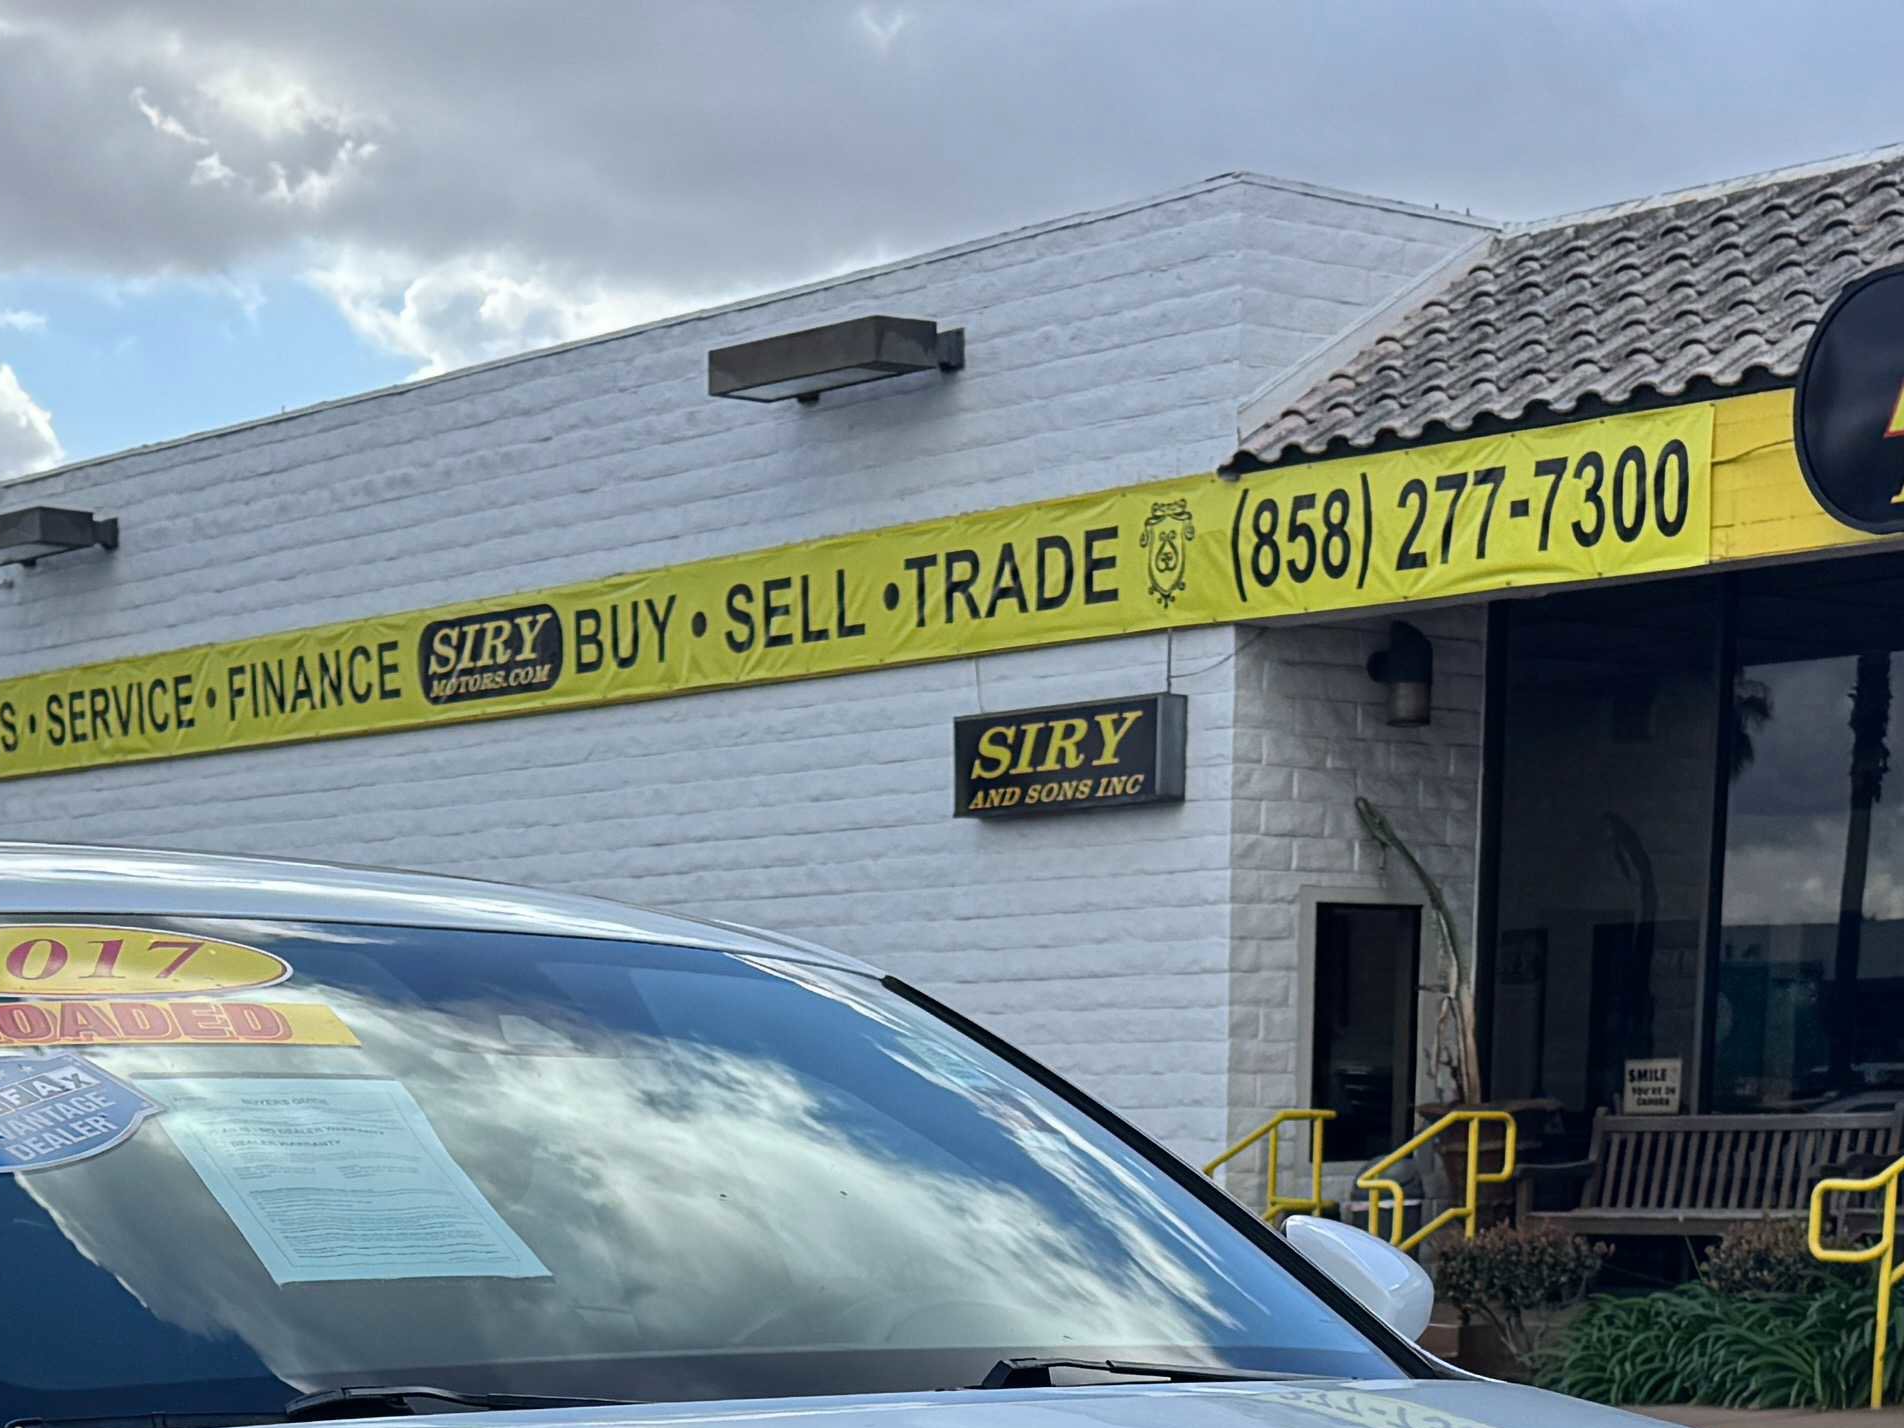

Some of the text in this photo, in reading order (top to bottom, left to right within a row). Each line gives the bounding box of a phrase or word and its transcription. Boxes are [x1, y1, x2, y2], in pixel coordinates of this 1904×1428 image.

[1230, 438, 1692, 604] (858) 277-7300
[574, 525, 1121, 674] BUY SELL TRADE
[428, 612, 552, 676] SIRY
[47, 673, 196, 746] SERVICE
[229, 640, 402, 721] FINANCE
[430, 664, 552, 698] MOTORS.COM
[970, 710, 1144, 780] SIRY
[968, 774, 1145, 810] AND SONS INC
[5, 1113, 119, 1162] DEALER
